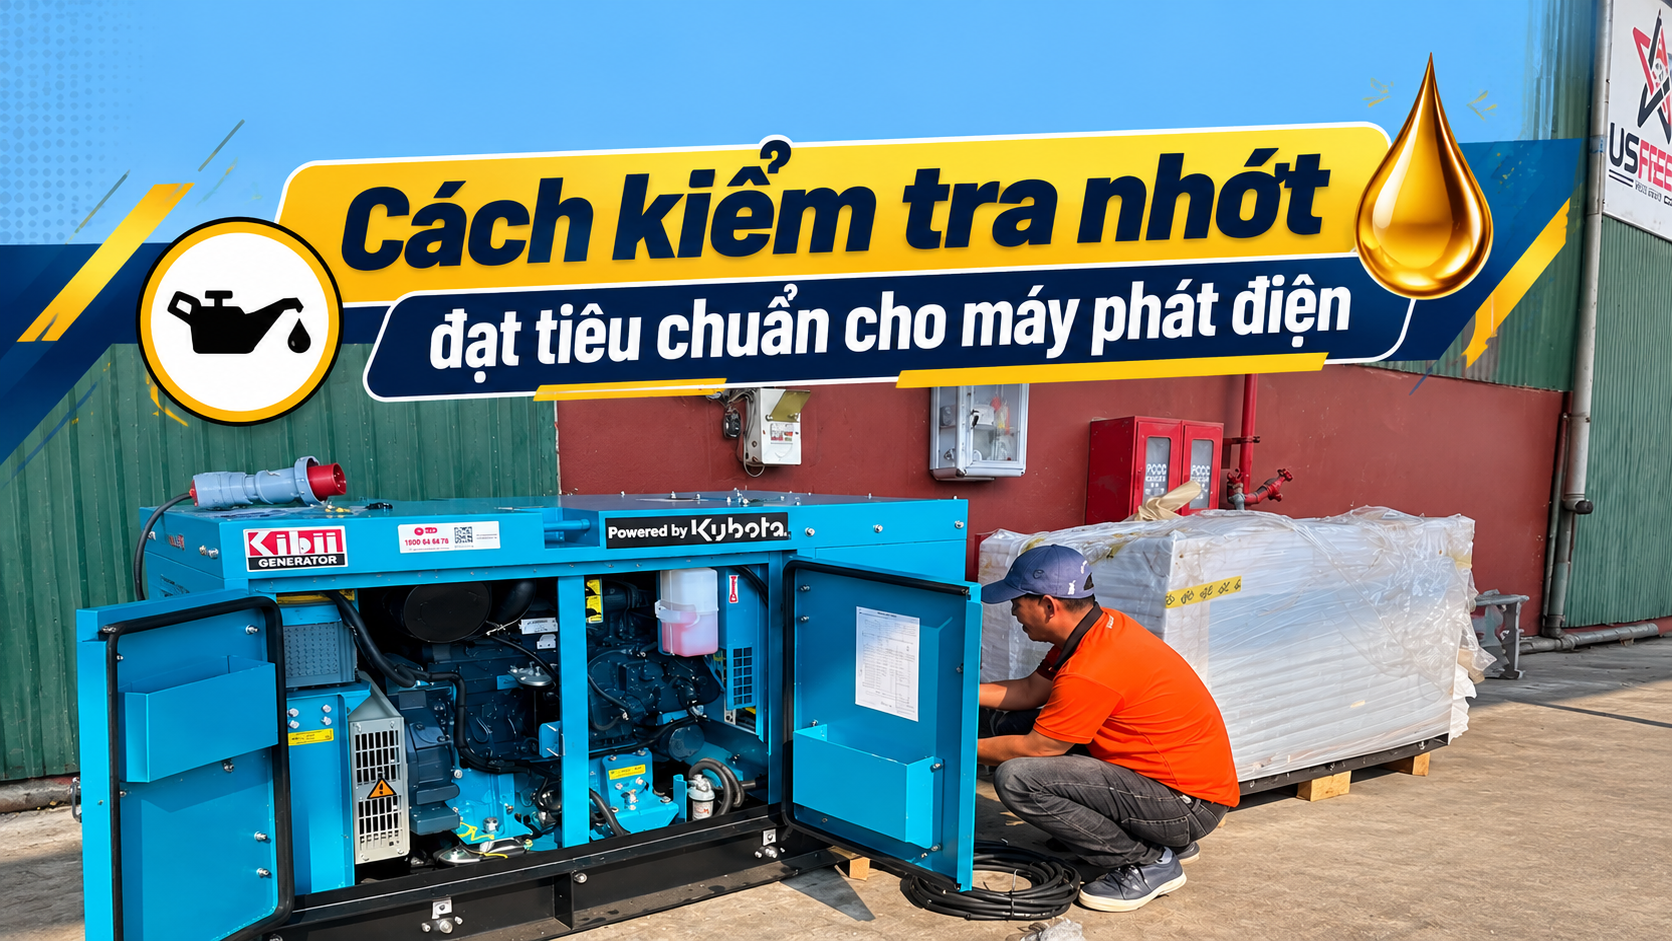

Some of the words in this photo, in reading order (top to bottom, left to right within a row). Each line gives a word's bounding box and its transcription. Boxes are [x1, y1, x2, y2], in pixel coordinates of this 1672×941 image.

[608, 525, 668, 539] Powered
[671, 524, 688, 539] by
[250, 531, 337, 556] Kibii
[258, 555, 337, 567] GENERATOR
